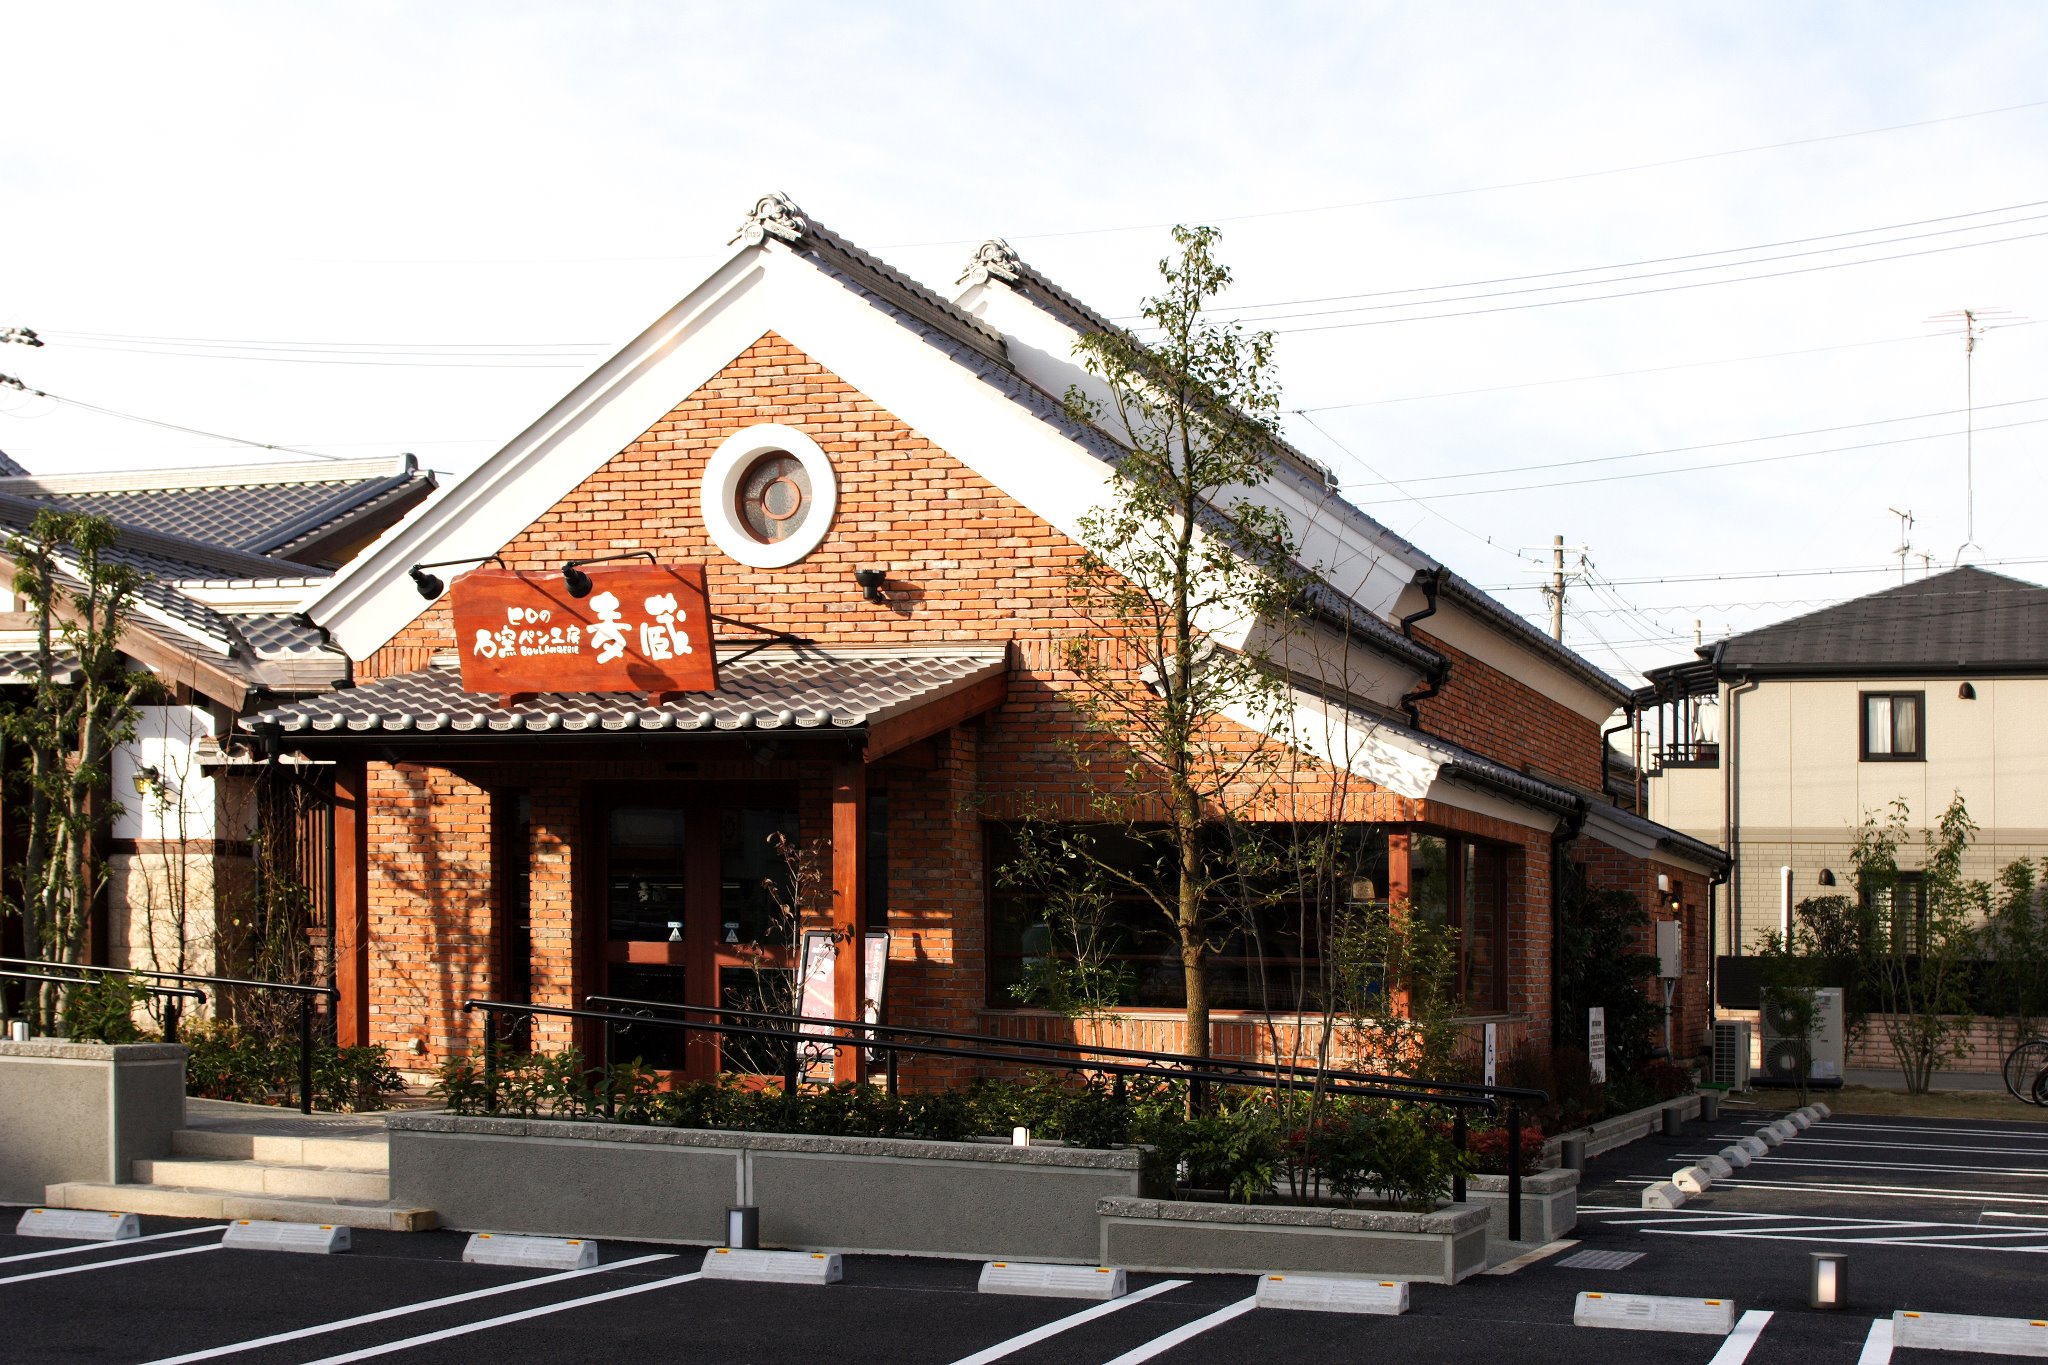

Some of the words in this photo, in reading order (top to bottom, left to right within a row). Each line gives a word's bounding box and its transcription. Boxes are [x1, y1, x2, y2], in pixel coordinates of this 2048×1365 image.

[507, 606, 551, 626] ヒロの
[519, 644, 580, 657] BOULANGERIE
